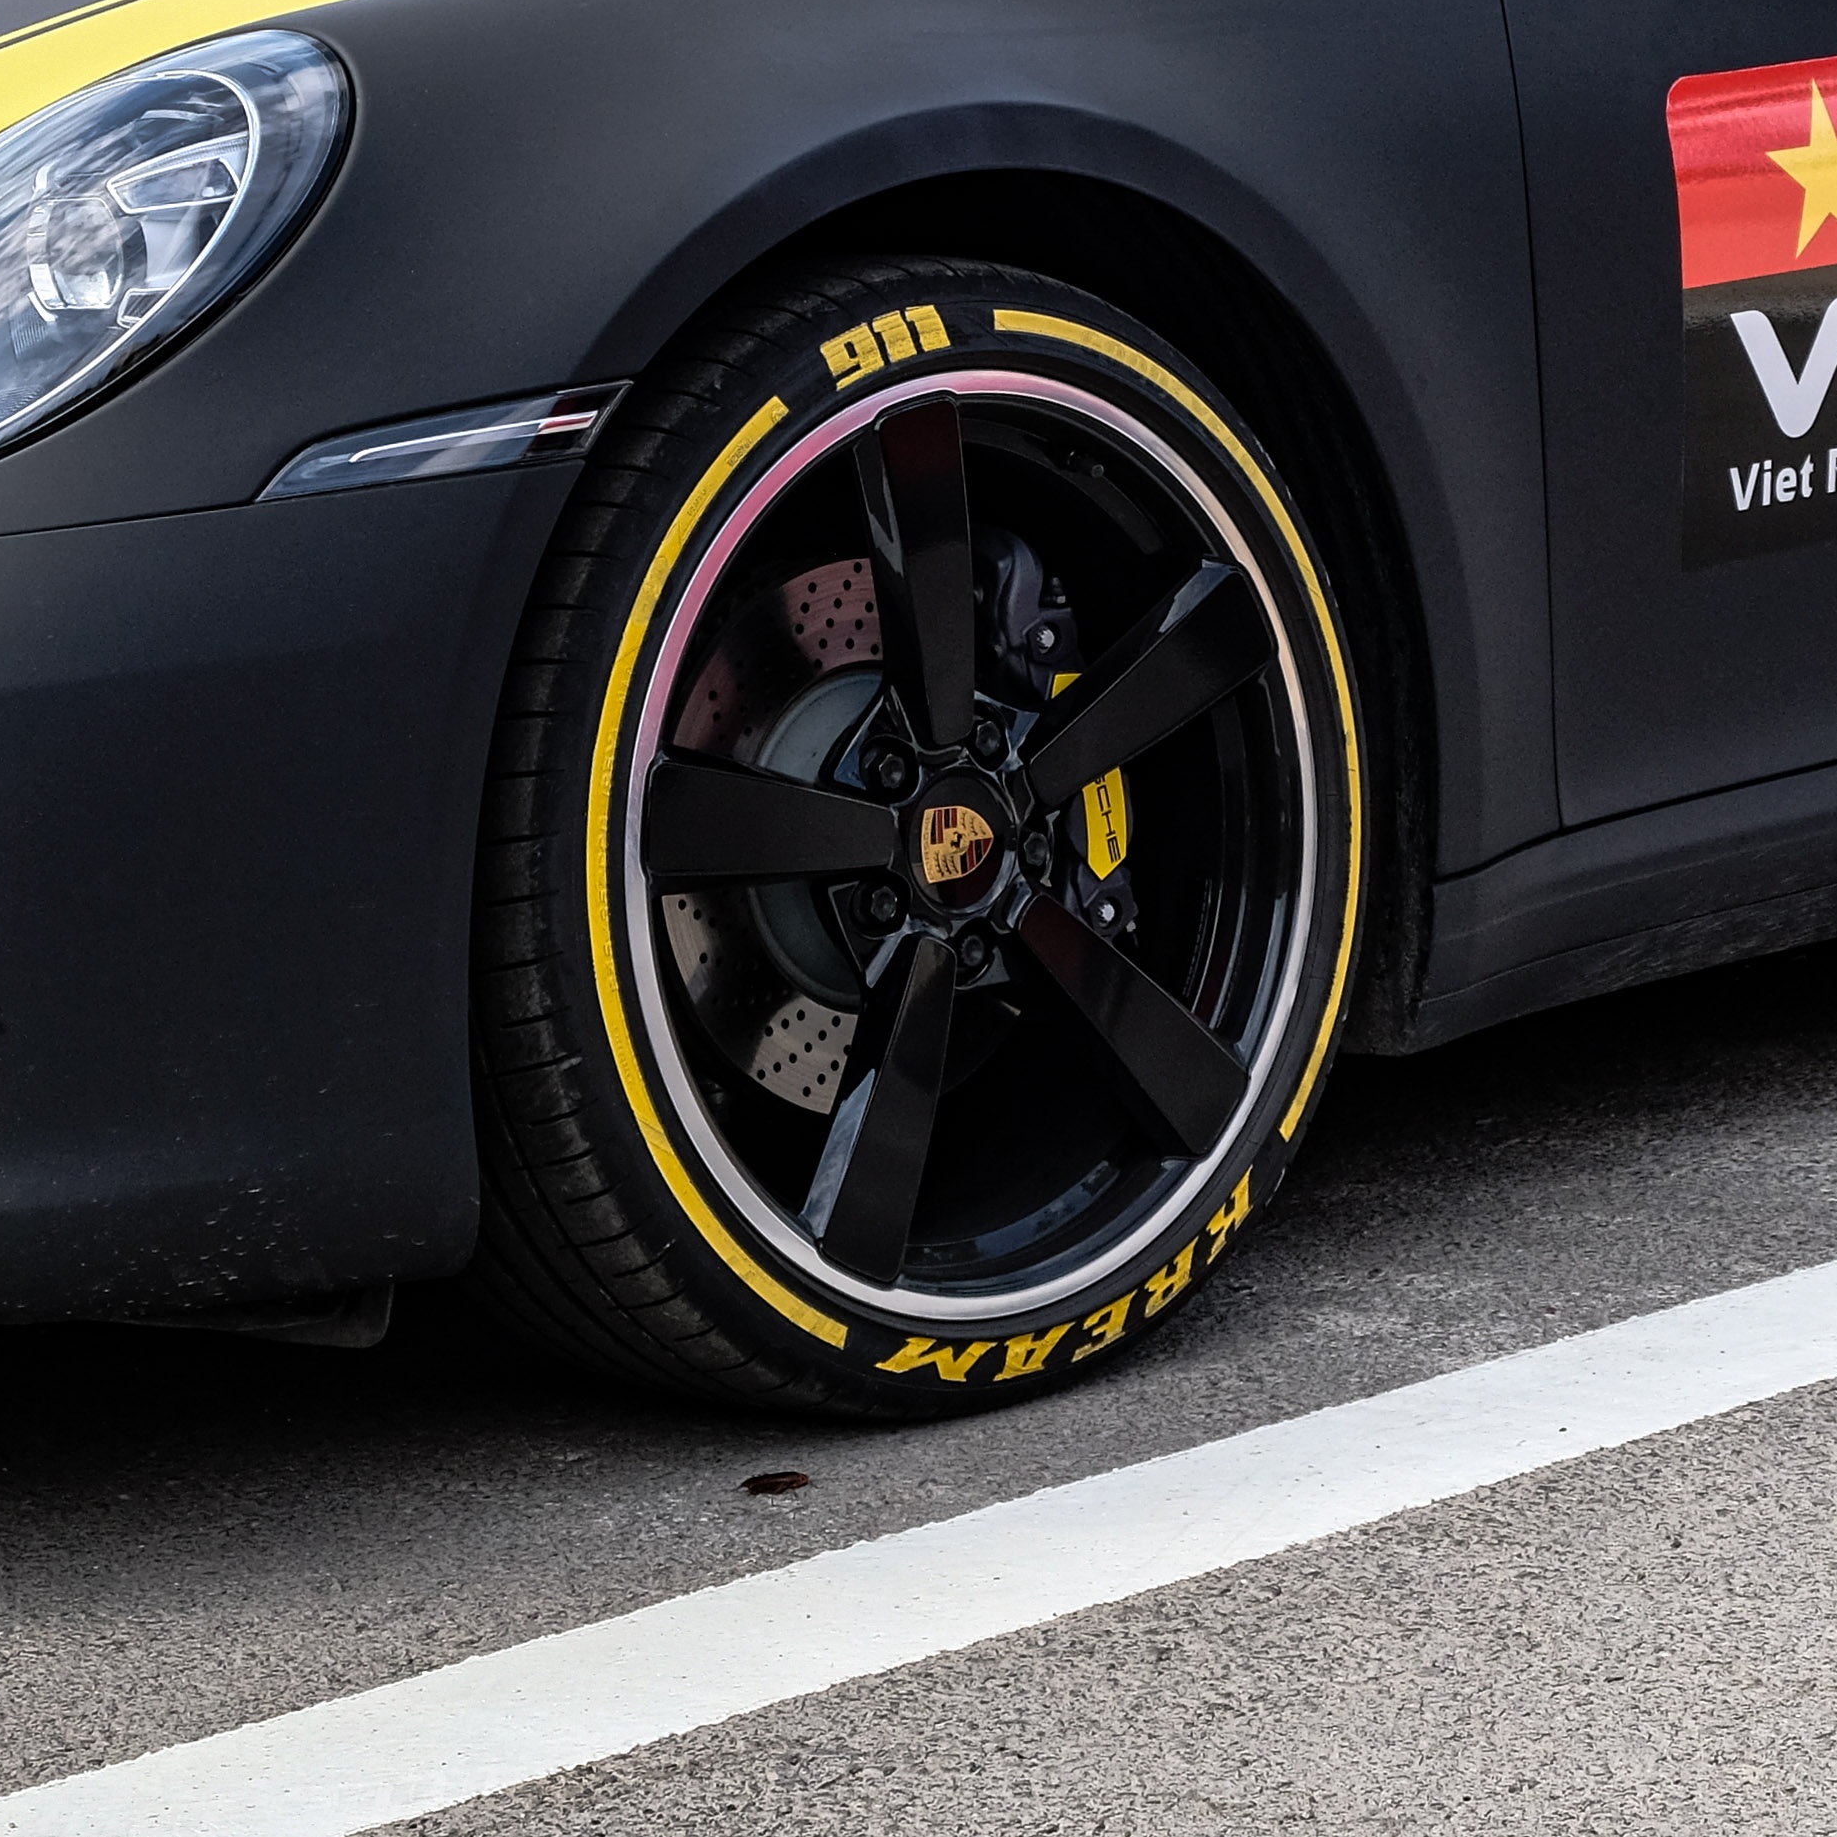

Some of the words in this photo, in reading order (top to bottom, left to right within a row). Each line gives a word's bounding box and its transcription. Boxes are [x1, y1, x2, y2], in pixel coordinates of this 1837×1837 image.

[820, 305, 951, 391] 911
[1730, 454, 1813, 511] Viet
[875, 1165, 1254, 1381] KREAM
